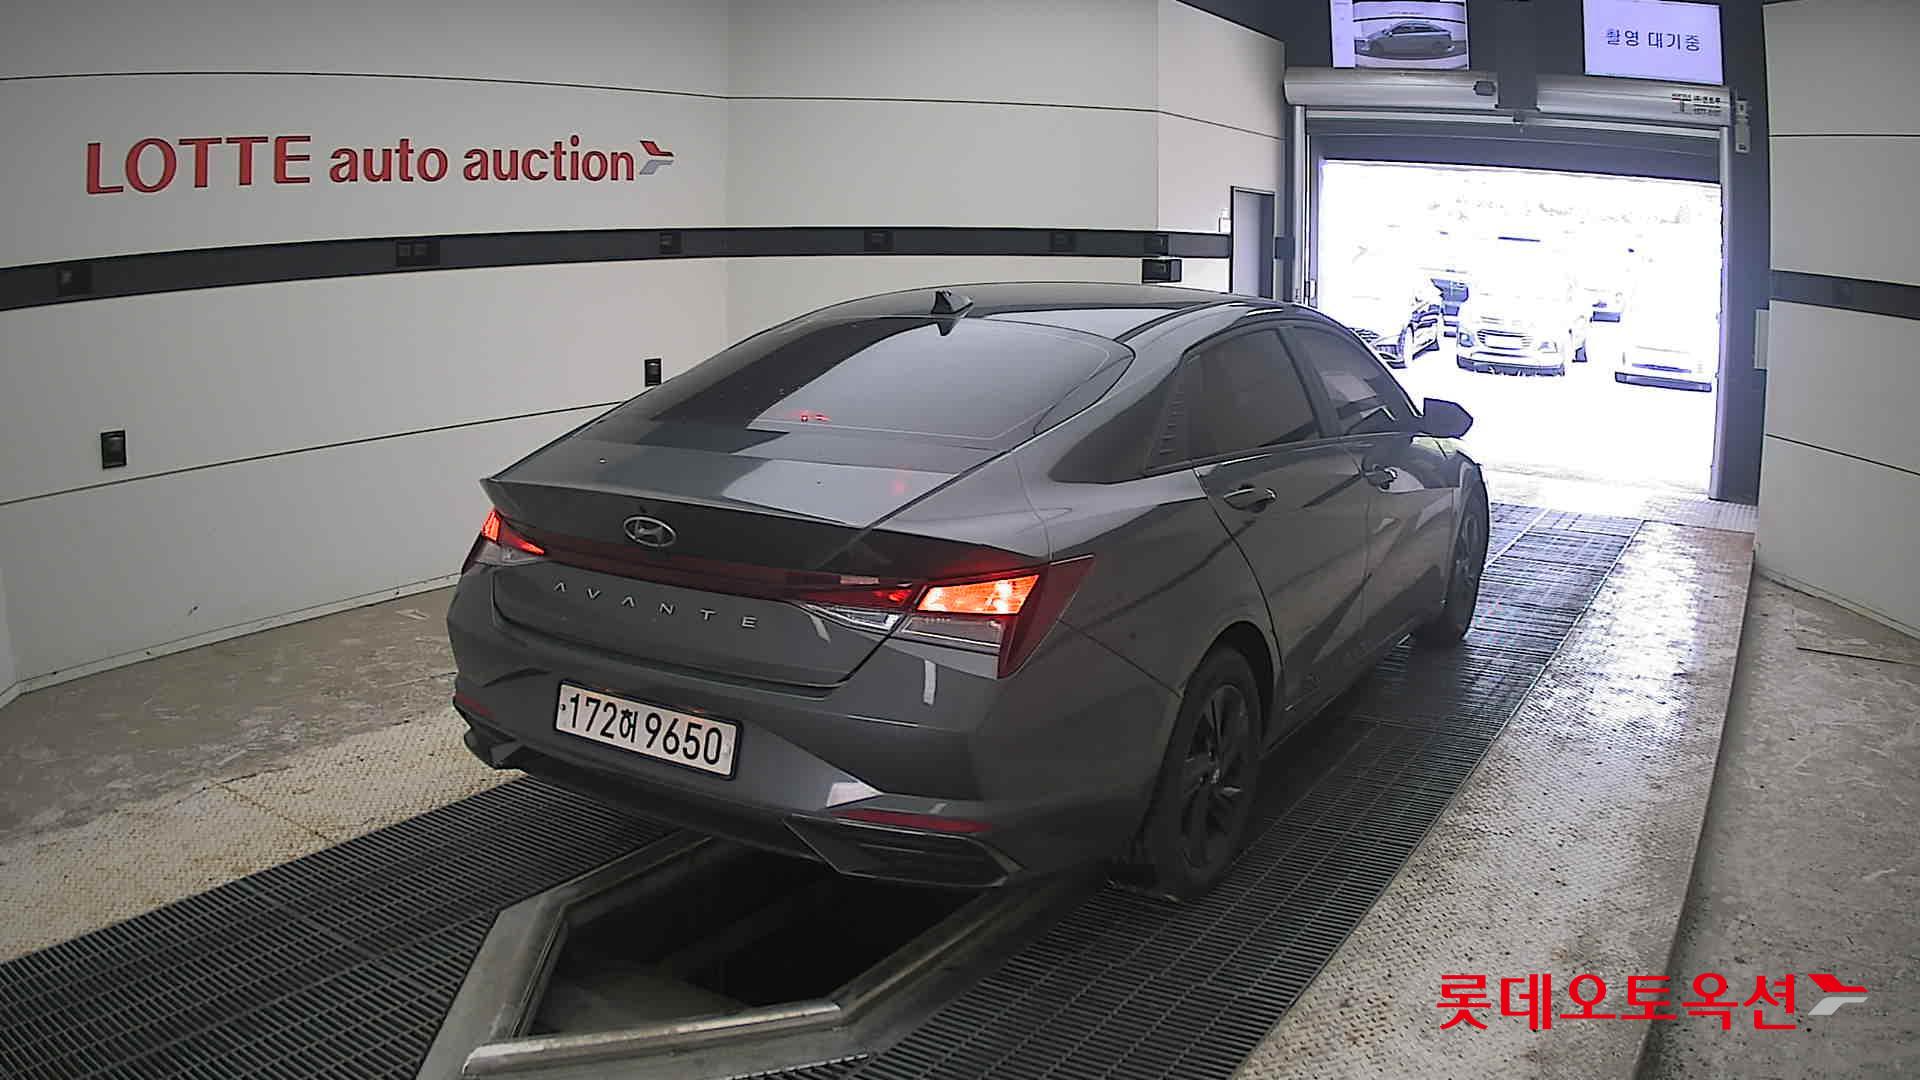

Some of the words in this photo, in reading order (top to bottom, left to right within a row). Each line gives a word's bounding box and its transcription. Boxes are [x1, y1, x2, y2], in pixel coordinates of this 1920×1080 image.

[85, 134, 312, 195] LOTTE
[329, 137, 449, 183] auto
[462, 134, 635, 184] auction
[553, 581, 758, 629] AVANTE
